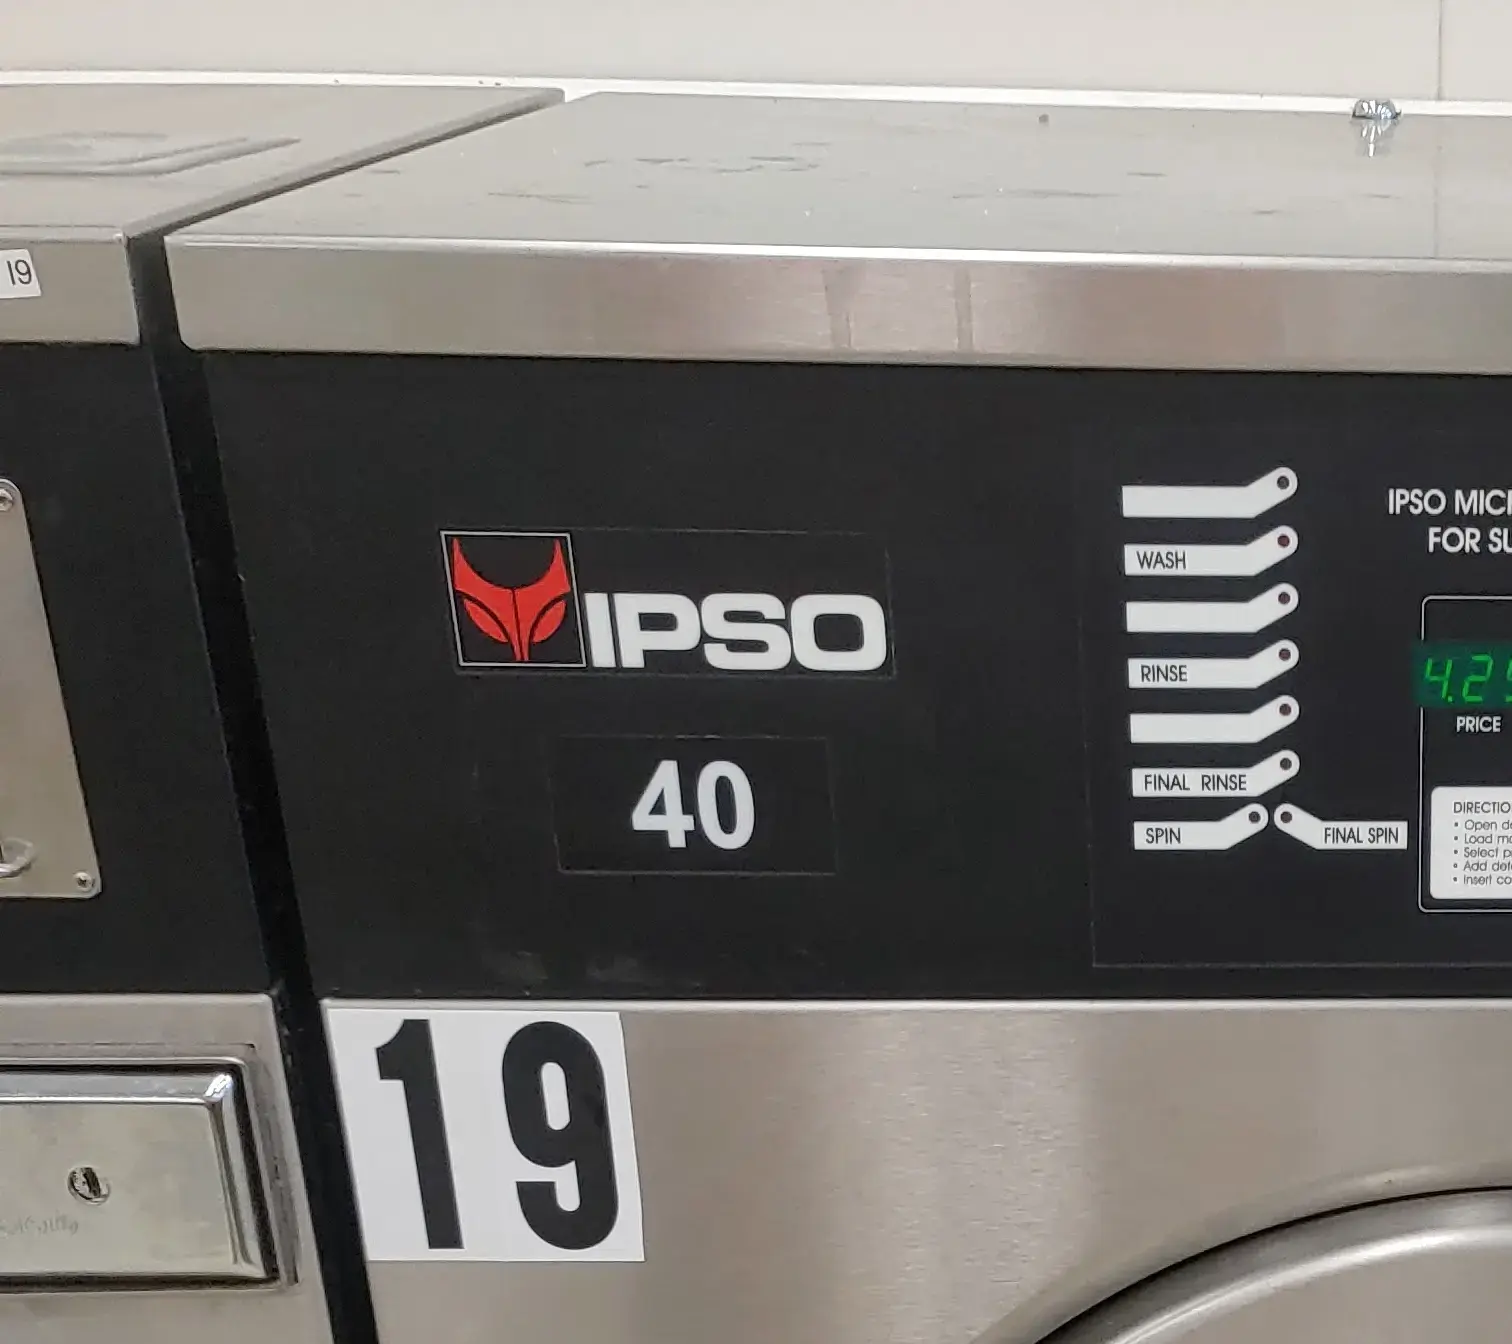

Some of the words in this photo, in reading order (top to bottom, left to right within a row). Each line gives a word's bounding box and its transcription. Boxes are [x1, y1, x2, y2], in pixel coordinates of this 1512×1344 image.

[1388, 488, 1446, 515] IPSO
[1428, 527, 1480, 553] FOR
[1137, 551, 1187, 570] WASH
[584, 592, 887, 671] IPSO
[1140, 665, 1188, 682] RINSE
[1456, 716, 1501, 733] PRICE
[1144, 775, 1190, 791] FINAL
[1201, 775, 1247, 791] RINSE
[632, 760, 755, 850] 40
[1464, 819, 1497, 832] Open
[1145, 828, 1181, 844] SPIN
[1324, 828, 1363, 844] FINAL
[1368, 828, 1399, 844] SPIN
[1464, 833, 1493, 844] Load
[1463, 847, 1499, 858] Select
[1463, 861, 1488, 872] Add
[1463, 874, 1492, 885] Insert
[375, 1018, 619, 1250] 19
